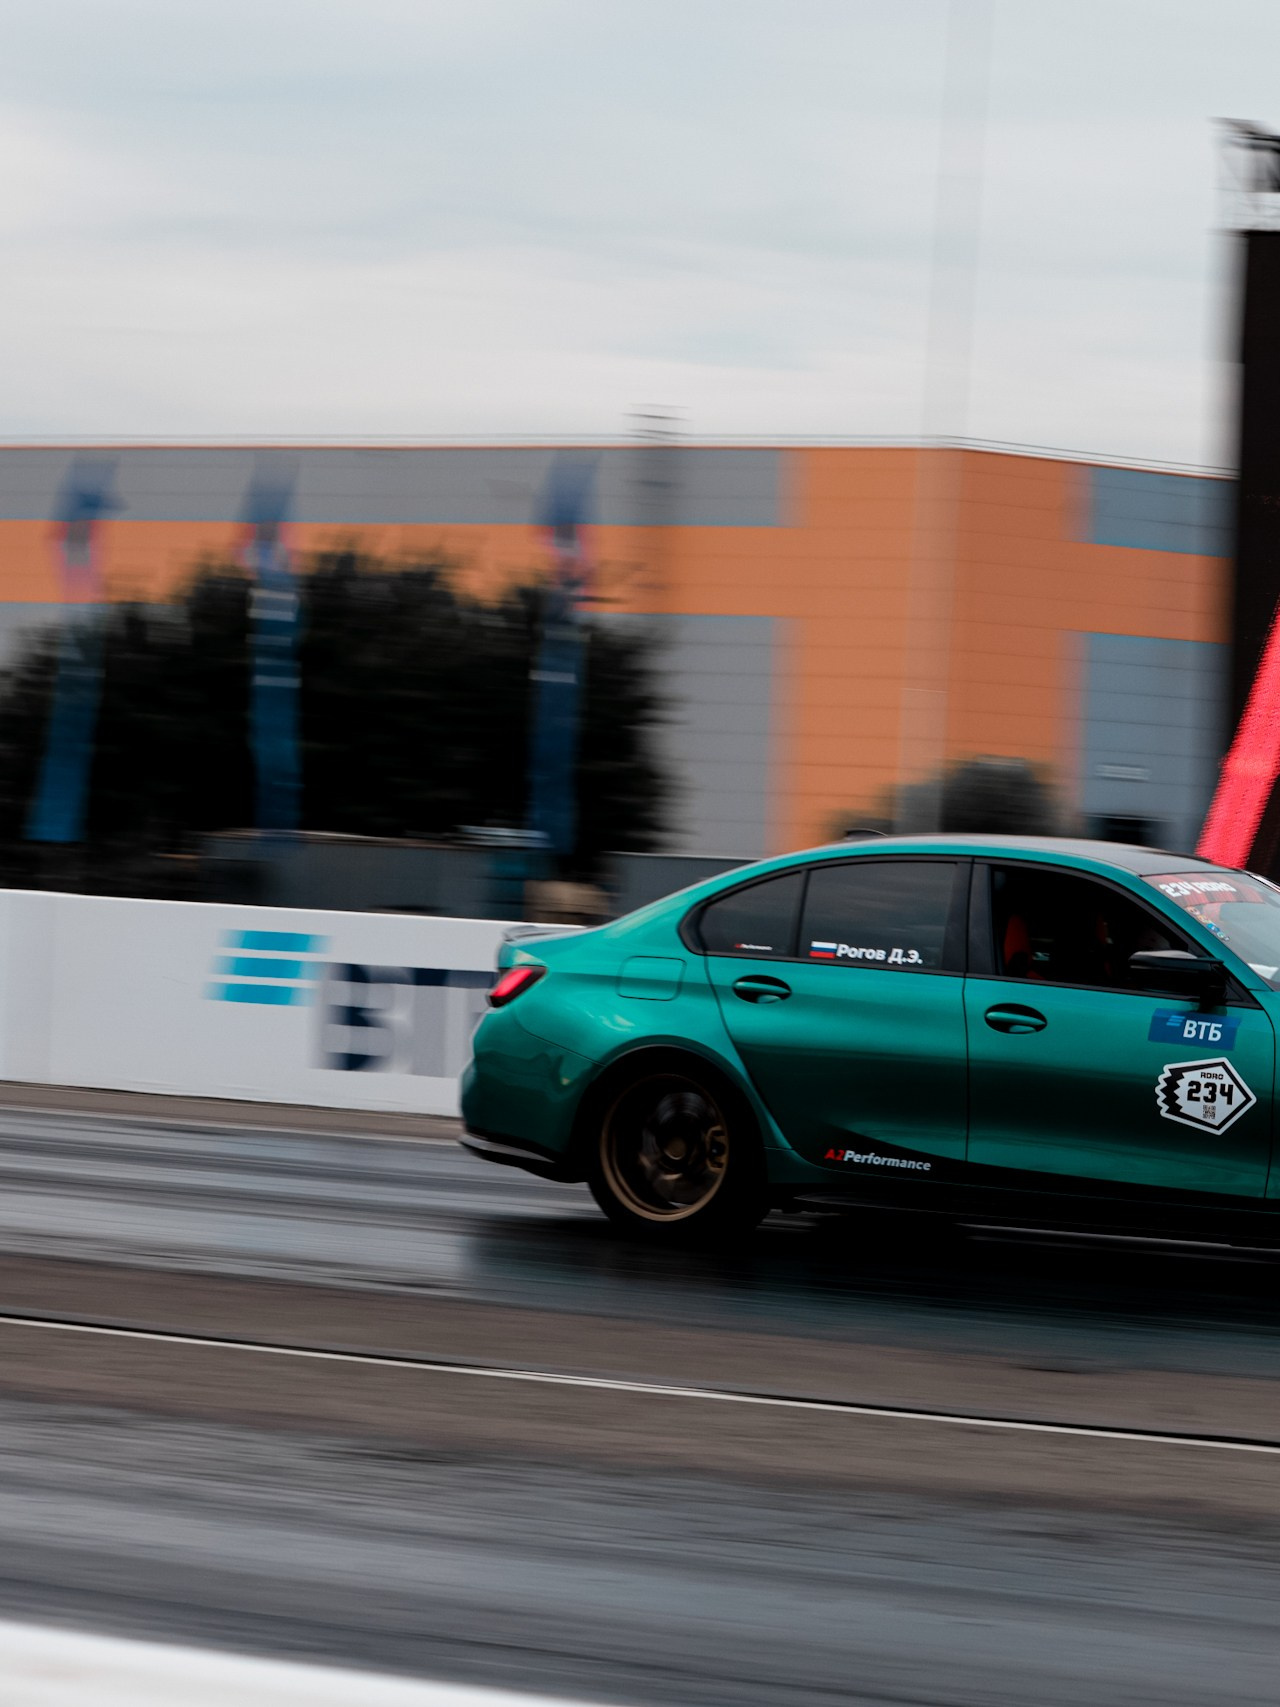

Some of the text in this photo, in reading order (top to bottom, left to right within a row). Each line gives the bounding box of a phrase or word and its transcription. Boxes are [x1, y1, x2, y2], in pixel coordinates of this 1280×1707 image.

[1159, 881, 1202, 897] 234
[836, 943, 924, 965] Рогов Д.Э.
[312, 961, 500, 1078] ВТ
[1182, 1019, 1223, 1042] ВТБ
[1186, 1080, 1235, 1106] 234
